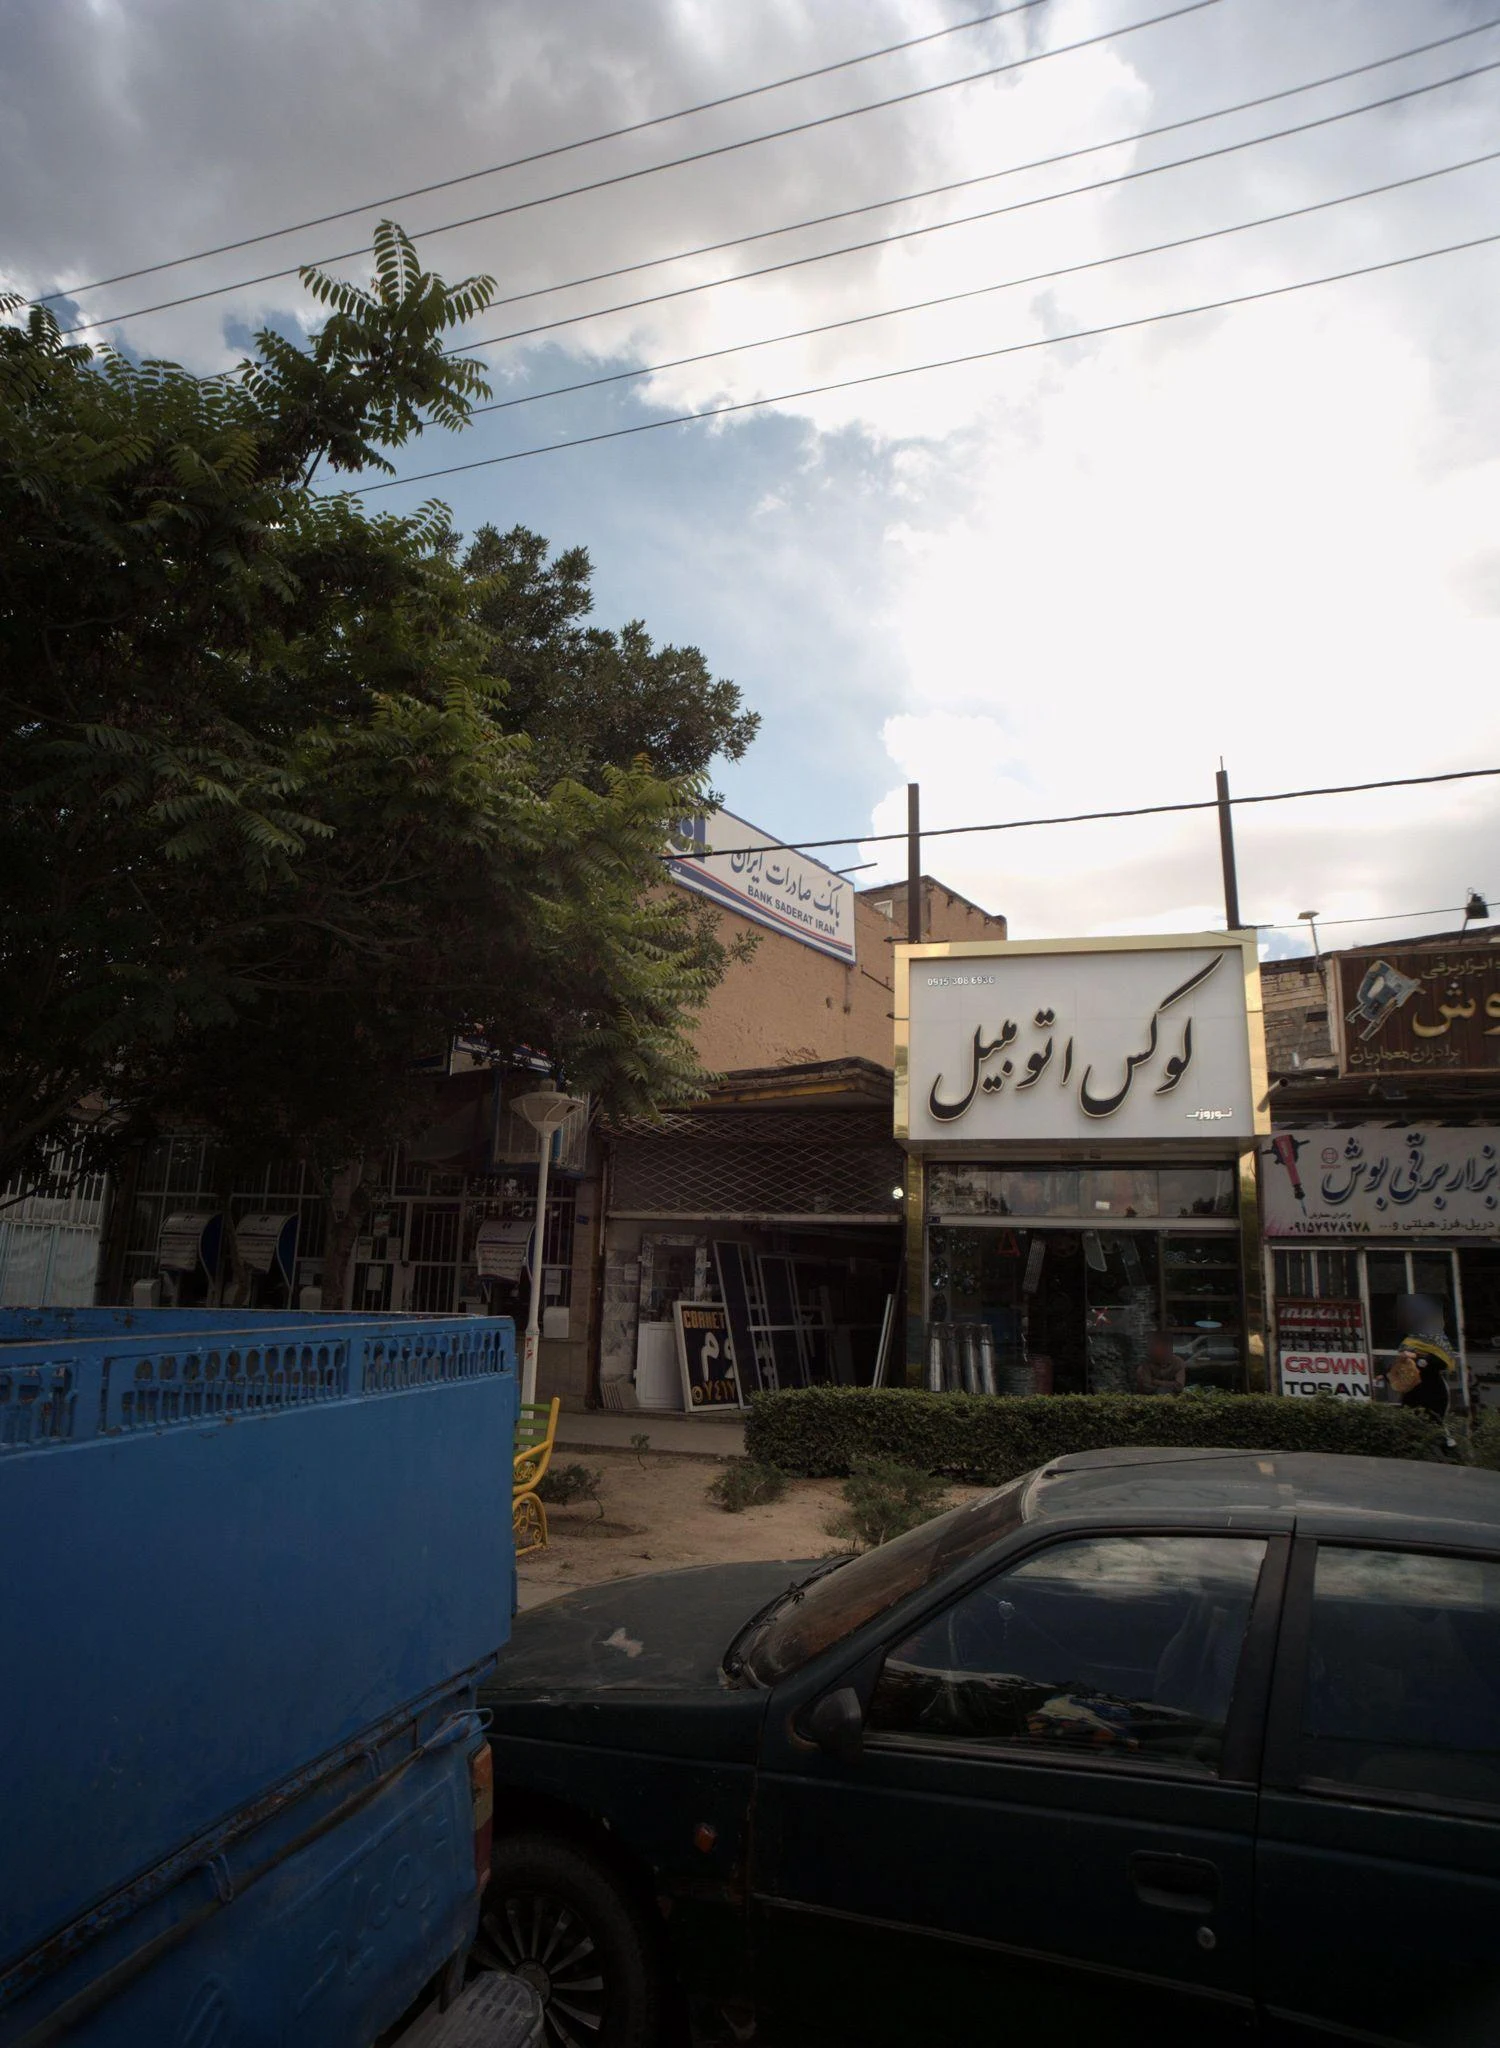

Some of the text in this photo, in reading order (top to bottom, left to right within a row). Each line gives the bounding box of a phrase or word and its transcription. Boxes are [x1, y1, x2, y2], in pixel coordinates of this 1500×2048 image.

[731, 846, 844, 928] بانک صادرات ایران
[747, 885, 835, 936] BANK SADERAT IRAN
[927, 977, 949, 986] 0915
[1080, 952, 1224, 1118] لوکس
[1321, 1137, 1389, 1211] بوش
[1389, 1132, 1449, 1210] برقی
[1284, 1381, 1370, 1396] TOSAN
[1285, 1356, 1367, 1375] CROWN
